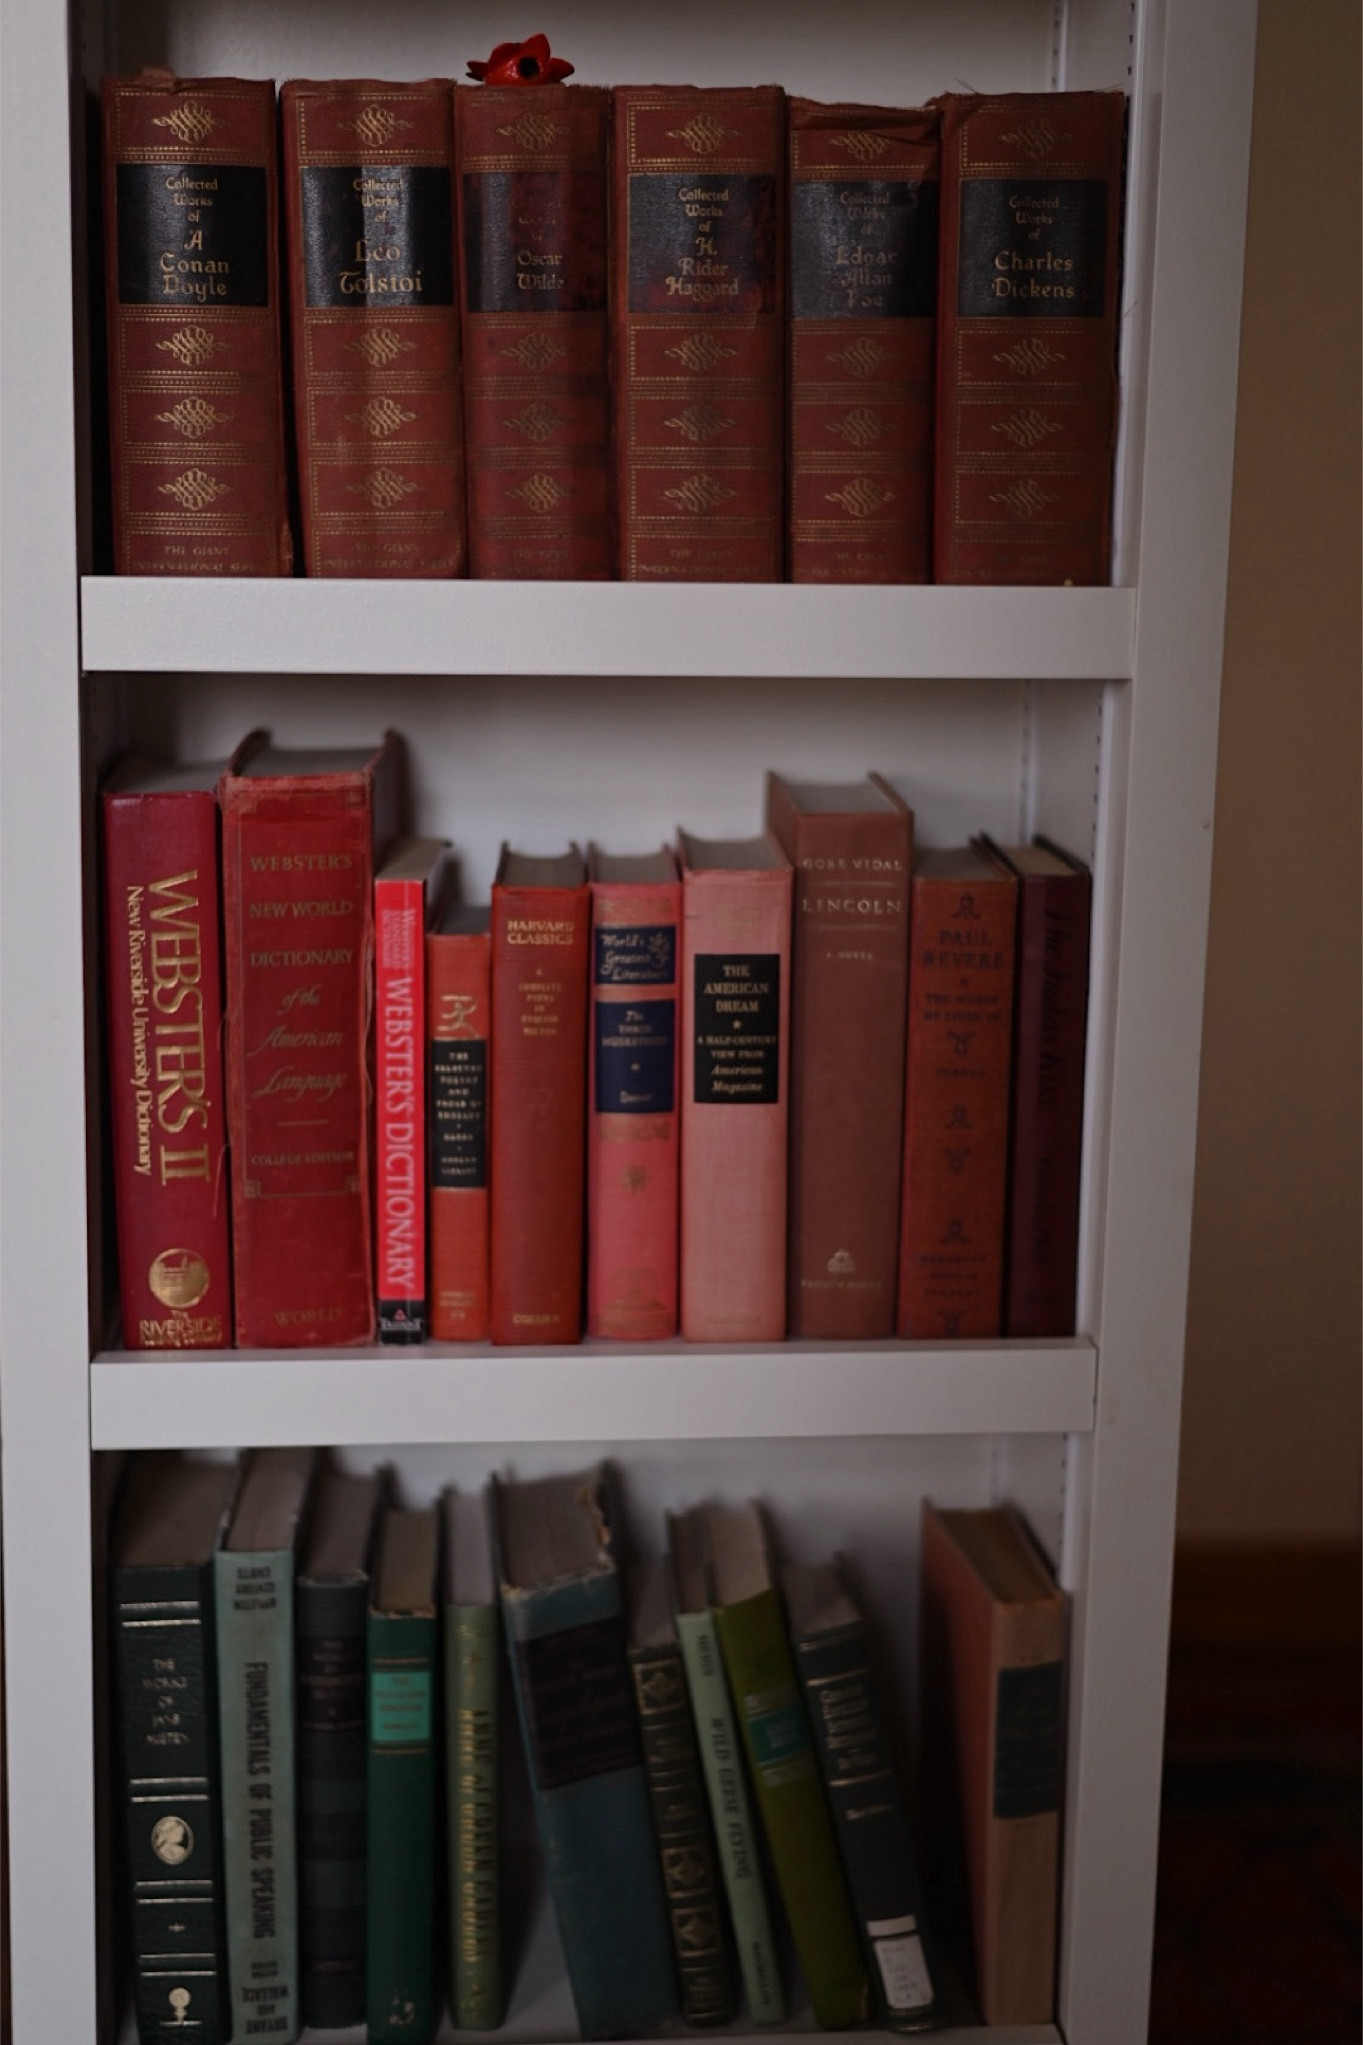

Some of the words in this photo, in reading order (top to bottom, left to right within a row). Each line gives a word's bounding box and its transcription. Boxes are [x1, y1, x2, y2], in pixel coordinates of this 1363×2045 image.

[165, 176, 218, 190] Collected
[352, 178, 405, 192] Collected
[172, 193, 213, 207] Works
[361, 193, 399, 207] Works
[678, 187, 730, 202] Collected
[839, 190, 890, 205] Collected
[1009, 194, 1060, 209] Collected
[187, 209, 200, 223] of
[374, 209, 388, 223] of
[685, 204, 723, 218] Works
[1015, 211, 1054, 225] Works
[698, 220, 712, 233] of
[1027, 227, 1041, 241] of
[184, 230, 203, 251] A
[352, 236, 401, 262] Leo
[695, 236, 718, 257] H.
[160, 252, 230, 274] Conan
[517, 250, 564, 266] Oscar
[836, 246, 899, 266] Edgar
[994, 250, 1075, 272] Charles
[678, 257, 728, 277] Rider
[338, 269, 424, 295] Tolstoi
[516, 273, 565, 291] Wilde
[841, 266, 893, 289] Allan
[162, 274, 228, 302] Doyle
[665, 275, 740, 303] Haggard
[992, 277, 1075, 299] Dickens
[250, 854, 353, 872] WEBSTER'S
[802, 858, 847, 870] GORE
[852, 858, 902, 871] VIDAL
[127, 886, 144, 927] New
[249, 901, 288, 918] NEW
[291, 899, 353, 917] WORLD
[801, 898, 901, 915] LINCOLN
[506, 919, 575, 932] HARVARD
[506, 933, 574, 946] CLASSICS
[939, 930, 991, 946] PAUL
[129, 929, 149, 1006] Riverside
[250, 948, 354, 968] DICTIONARY
[923, 952, 1005, 969] REVERE
[722, 963, 751, 978] THE
[703, 981, 770, 995] AMERICAN
[148, 869, 212, 1133] WEBSTER'S
[277, 984, 307, 1016] of
[714, 1000, 760, 1014] DREAM
[130, 1006, 152, 1089] University
[246, 1025, 345, 1057] American
[385, 975, 415, 1117] WEBSTER'S
[710, 1064, 764, 1076] American
[250, 1063, 348, 1103] Language
[134, 1089, 153, 1176] Dictionary
[160, 1142, 211, 1187] II
[385, 1122, 416, 1290] DICTIONARY
[272, 1306, 343, 1328] WORLD
[245, 1661, 272, 1777] FUNDAMENTALS
[248, 1783, 271, 1800] OF
[249, 1807, 273, 1862] PUBLIC
[727, 1821, 752, 1879] FLYING
[251, 1867, 276, 1940] SPEAKING
